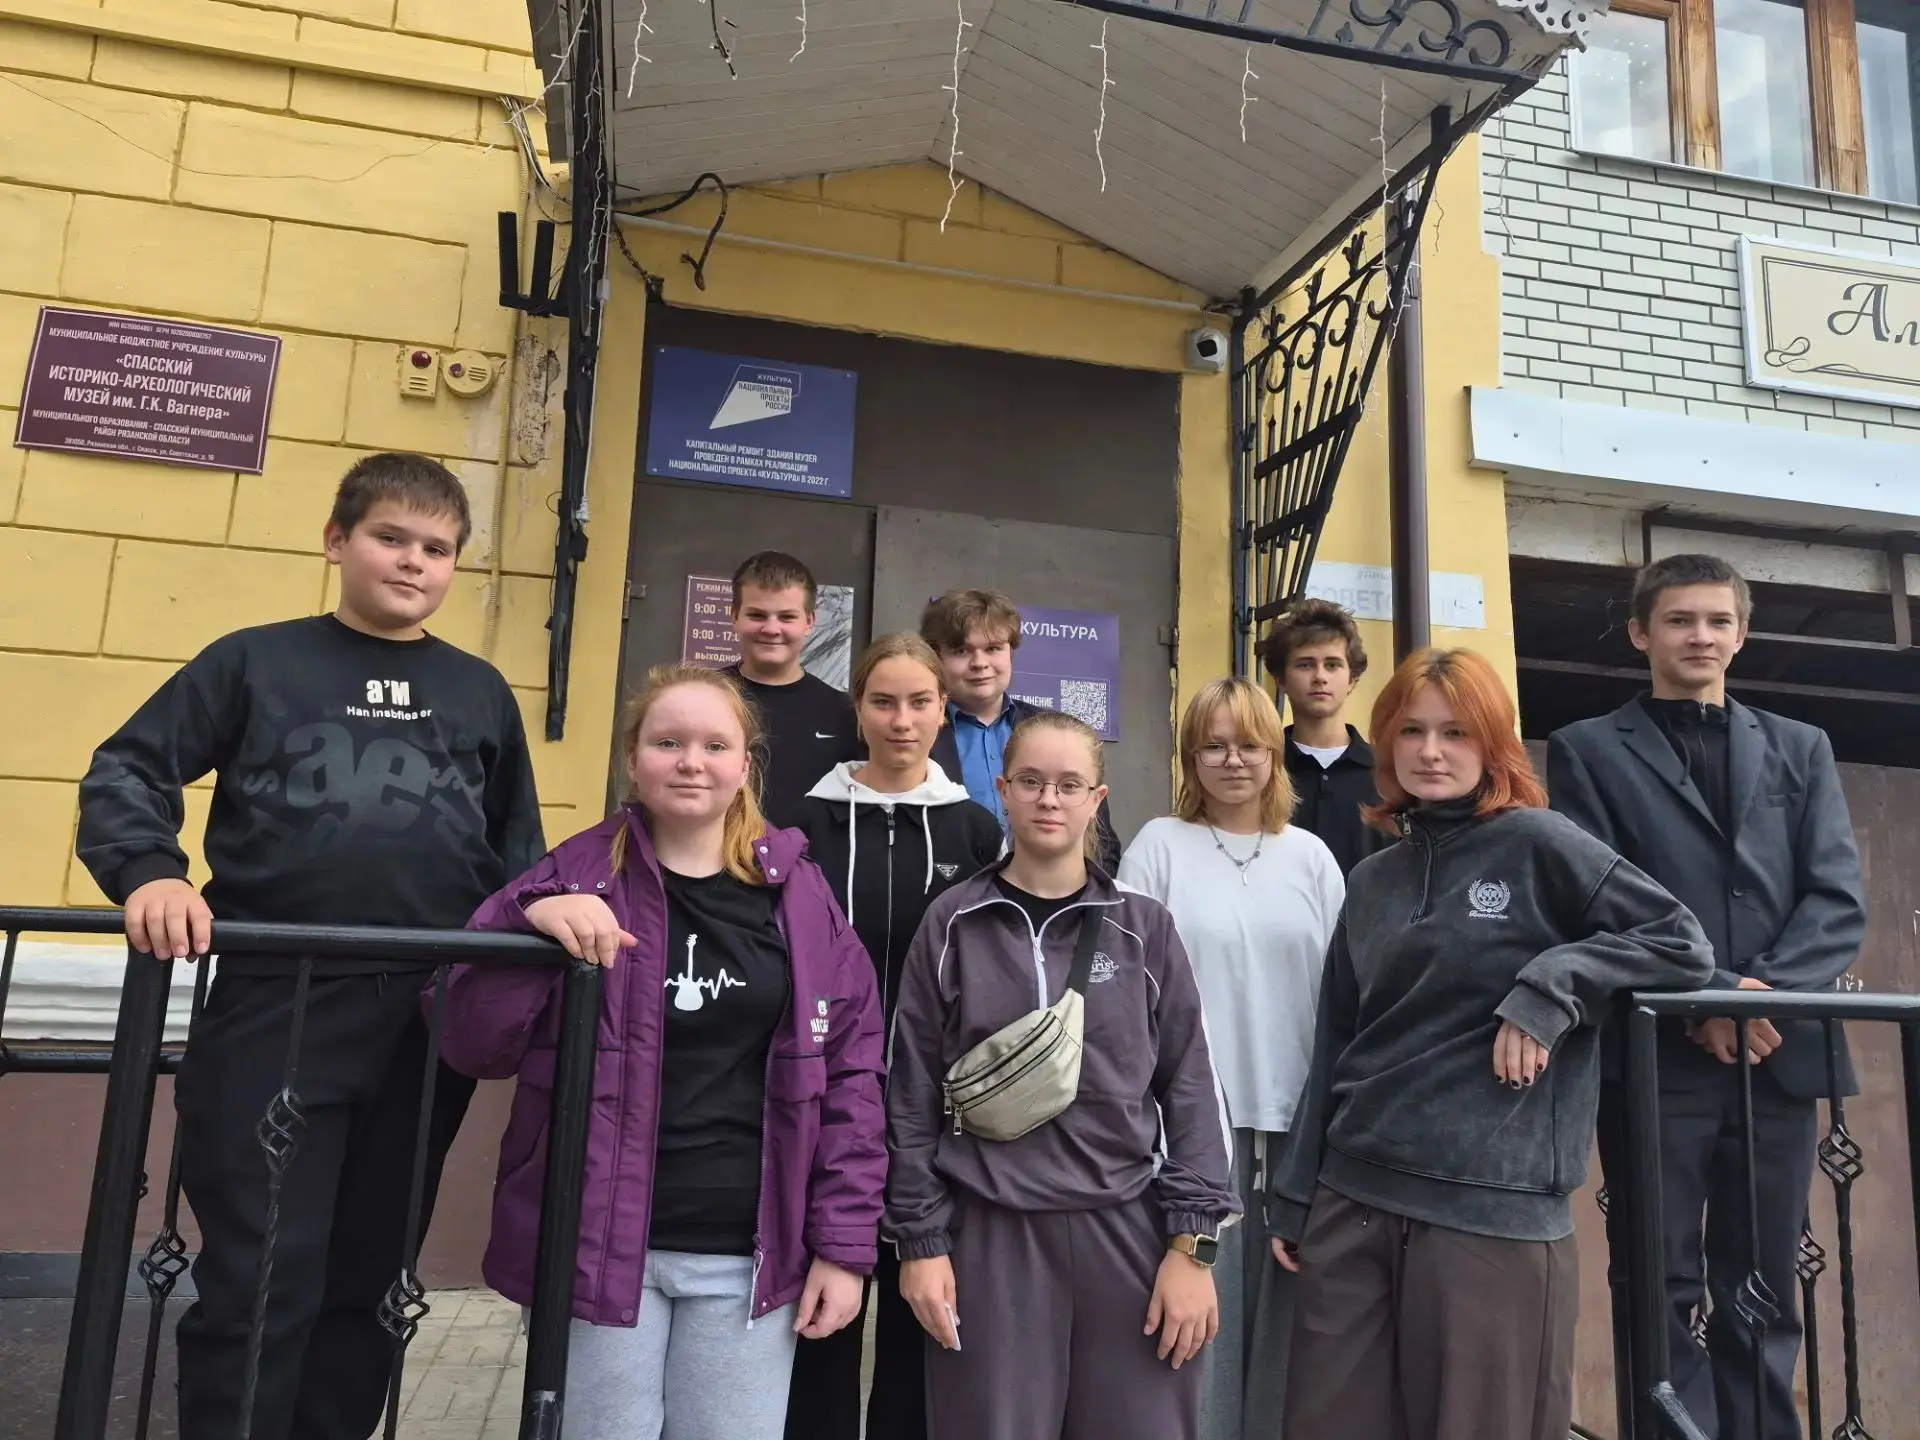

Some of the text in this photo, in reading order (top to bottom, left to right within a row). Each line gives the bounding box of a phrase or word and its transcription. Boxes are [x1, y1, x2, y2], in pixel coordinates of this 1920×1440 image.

[49, 327, 268, 363] МУНИЦИПАЛЬНОЕ БЮДЖЕТНОЕ УЧРЕЖДЕНИЕ КУЛЬТУРЫ
[116, 353, 193, 376] «СПАССКИЙ
[49, 365, 252, 403] ИСТОРИКО-АРХЕОЛОГИЧЕСКИЙ
[738, 382, 790, 396] НАЦИОНАЛЬНЫЕ
[757, 374, 792, 384] КУЛЬТУРА
[64, 386, 231, 420] МУЗЕЙ им. Г.К. Вагнера»
[760, 393, 790, 404] ПРОЕКТЫ
[765, 401, 790, 411] РОССИИ
[32, 409, 98, 424] МУНИЦИПАЛЬНОГО
[99, 416, 148, 429] ОБРАЗОВАНИЯ
[153, 422, 190, 434] СПАССКИЙ
[190, 427, 254, 443] МУНИЦИПАЛЬНЫЙ
[93, 426, 190, 445] РАЙОН РЯЗАНСКОЙ ОБЛАСТИ
[685, 439, 817, 463] КАПИТАЛЬНЫЙ РЕМОНТ ЗДАНИЯ МУЗЕЯ
[694, 451, 808, 472] ПРОВЕДЕН В РАМКАХ РЕАЛИЗАЦИИ
[668, 459, 727, 474] НАЦИОНАЛЬНОГО
[727, 466, 757, 477] ПРОЕКТА
[757, 470, 800, 483] «КУЛЬТУРА»
[801, 475, 806, 483] В
[807, 475, 824, 485] 2022
[694, 602, 716, 615] 9:00
[692, 628, 714, 640] 9:00
[1019, 620, 1099, 641] КУЛЬТУРА
[346, 705, 370, 717] Han
